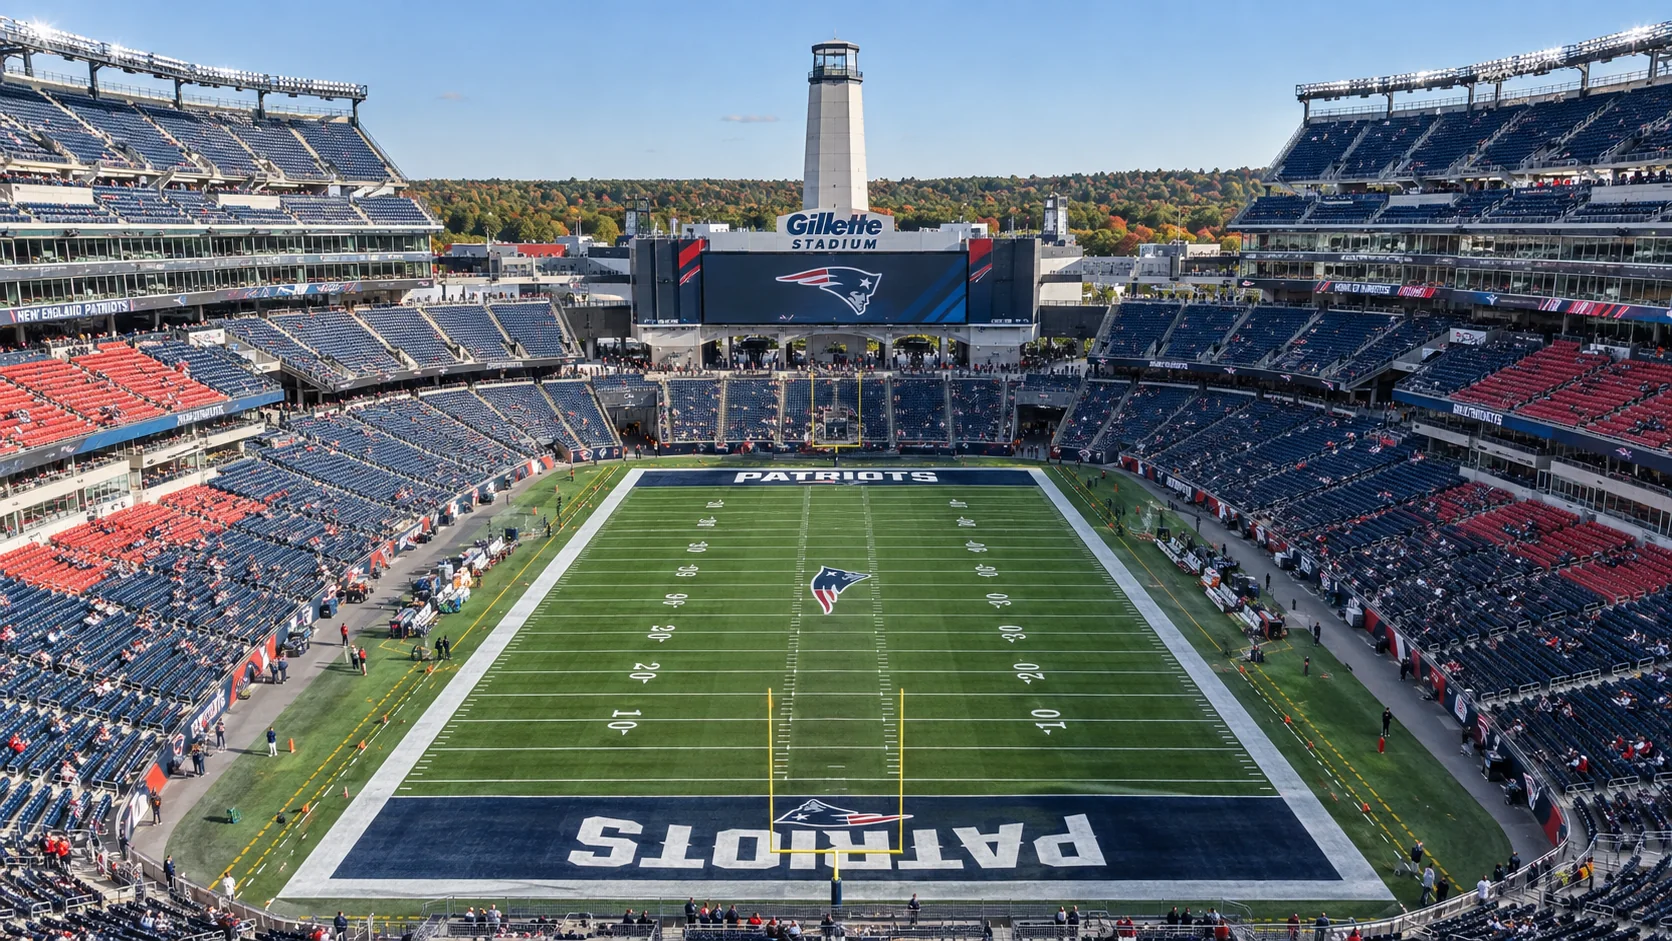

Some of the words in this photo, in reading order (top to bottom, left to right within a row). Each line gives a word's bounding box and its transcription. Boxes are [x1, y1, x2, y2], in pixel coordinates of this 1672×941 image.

[787, 212, 882, 235] Gillette
[792, 239, 877, 249] STADIUM
[17, 309, 39, 322] NEW
[733, 471, 939, 483] PATRIOTS
[998, 625, 1027, 640] 30
[629, 662, 661, 679] 20
[1013, 663, 1045, 680] 20
[607, 709, 642, 729] 10
[1031, 709, 1067, 729] 10
[567, 813, 1107, 869] PATRIOTS
